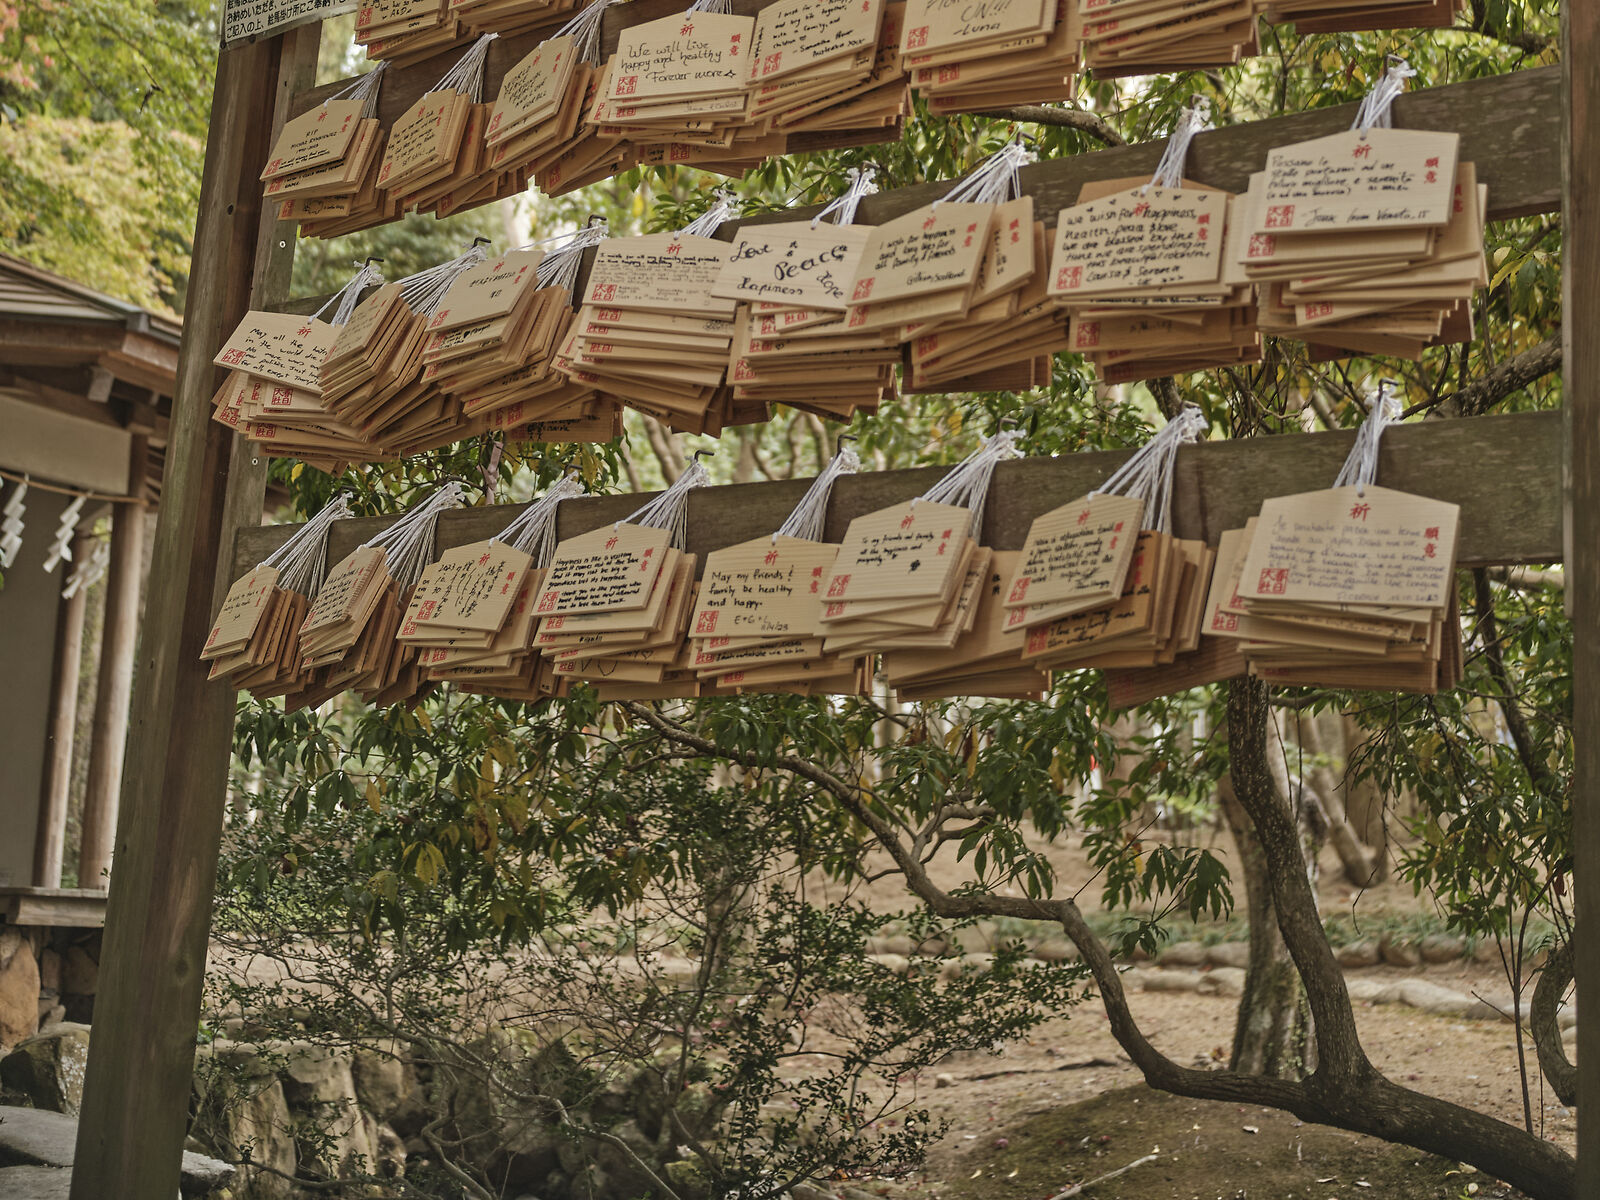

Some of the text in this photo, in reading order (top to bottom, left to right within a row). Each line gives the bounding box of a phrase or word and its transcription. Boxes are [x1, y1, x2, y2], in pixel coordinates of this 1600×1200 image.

[784, 8, 798, 18] wish
[680, 23, 695, 37] 祈
[628, 42, 651, 58] We
[656, 41, 681, 55] will
[621, 50, 722, 73] happy and healthy
[645, 70, 723, 83] Forever more
[1352, 144, 1372, 159] 祈
[887, 239, 904, 249] wish
[908, 235, 919, 244] for
[666, 244, 682, 255] 祈
[730, 241, 774, 262] Love
[879, 250, 896, 261] and
[875, 261, 888, 270] all
[250, 328, 267, 339] May
[290, 340, 303, 348] the
[297, 326, 311, 338] 祈
[260, 340, 271, 350] the
[264, 352, 281, 360] more
[267, 369, 290, 379] except
[289, 366, 306, 375] Just
[1350, 503, 1370, 521] 祈
[764, 551, 779, 566] 祈
[712, 569, 783, 582] May my friends
[709, 584, 793, 596] family be healthy
[707, 598, 763, 610] and happy.
